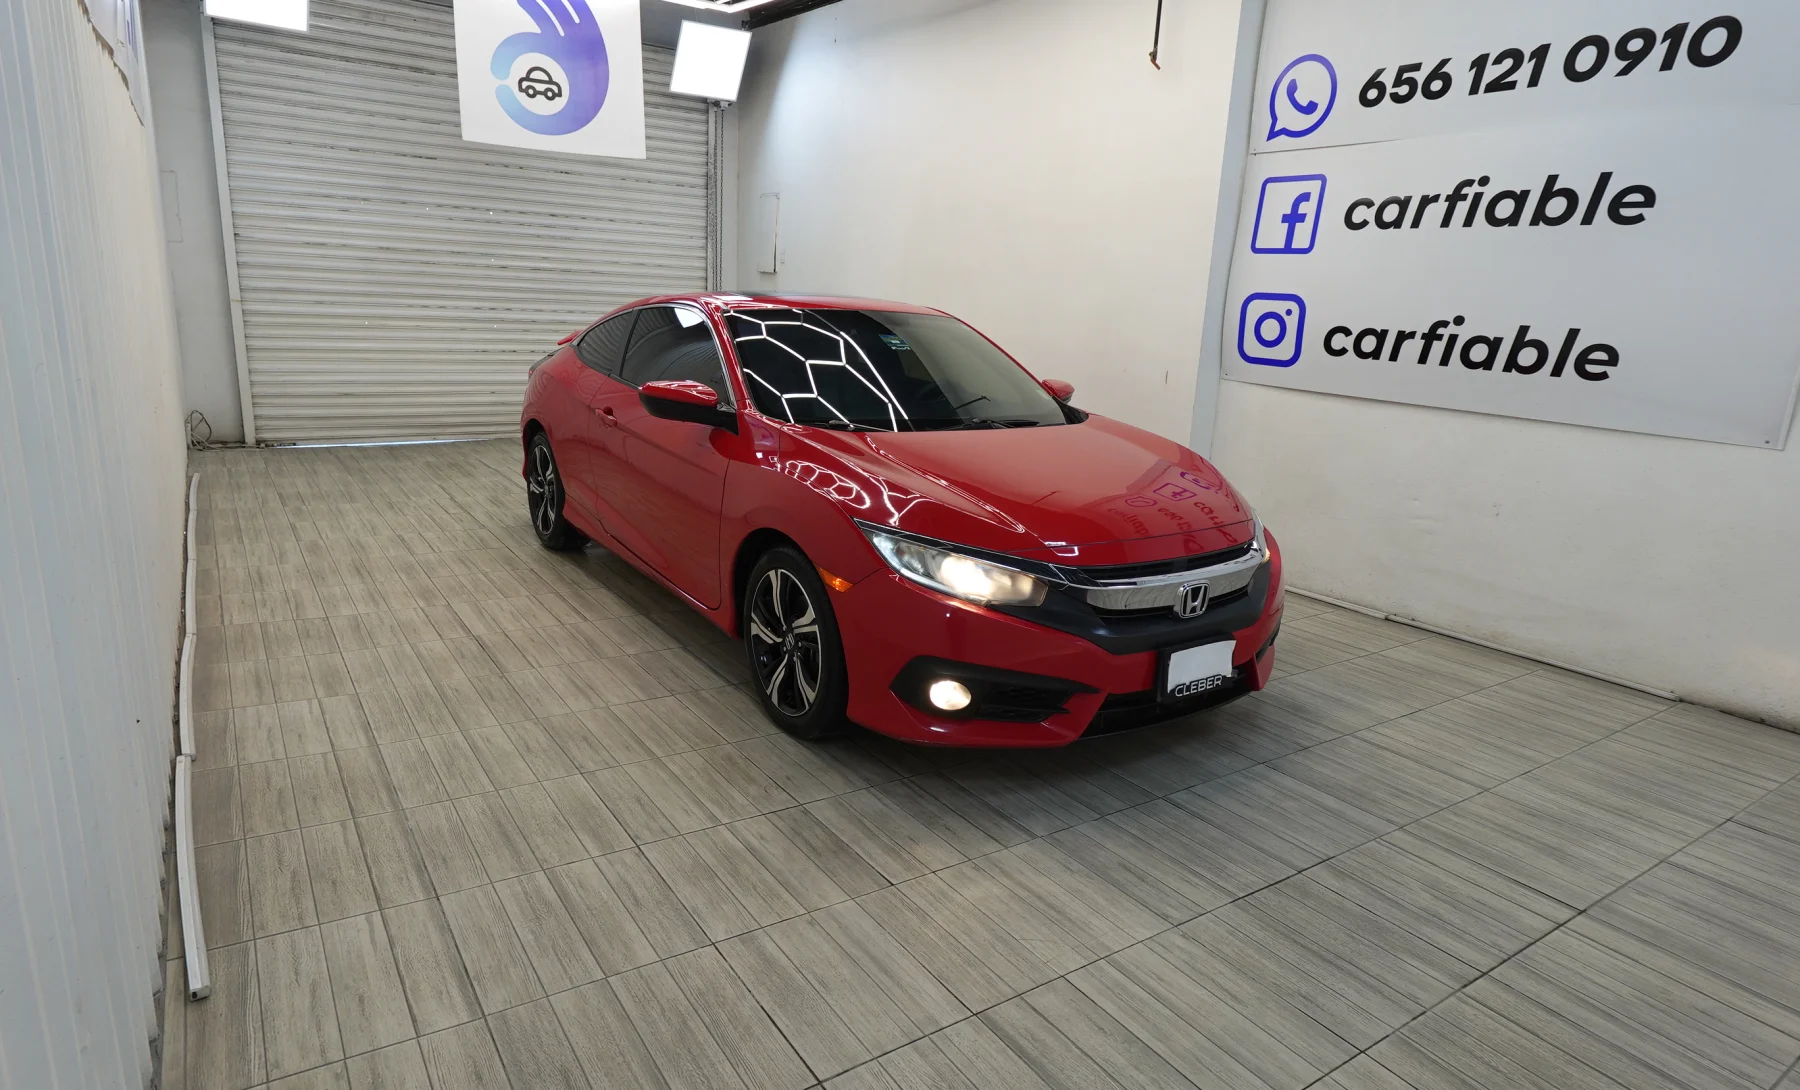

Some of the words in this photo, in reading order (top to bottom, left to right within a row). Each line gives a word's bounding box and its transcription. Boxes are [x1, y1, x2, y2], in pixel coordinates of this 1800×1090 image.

[1358, 57, 1453, 108] 656
[1468, 42, 1552, 96] 121
[1562, 15, 1743, 83] 0910
[1343, 171, 1657, 231] carfiable
[1323, 314, 1620, 382] carfiable
[1174, 675, 1223, 697] CLEBER
